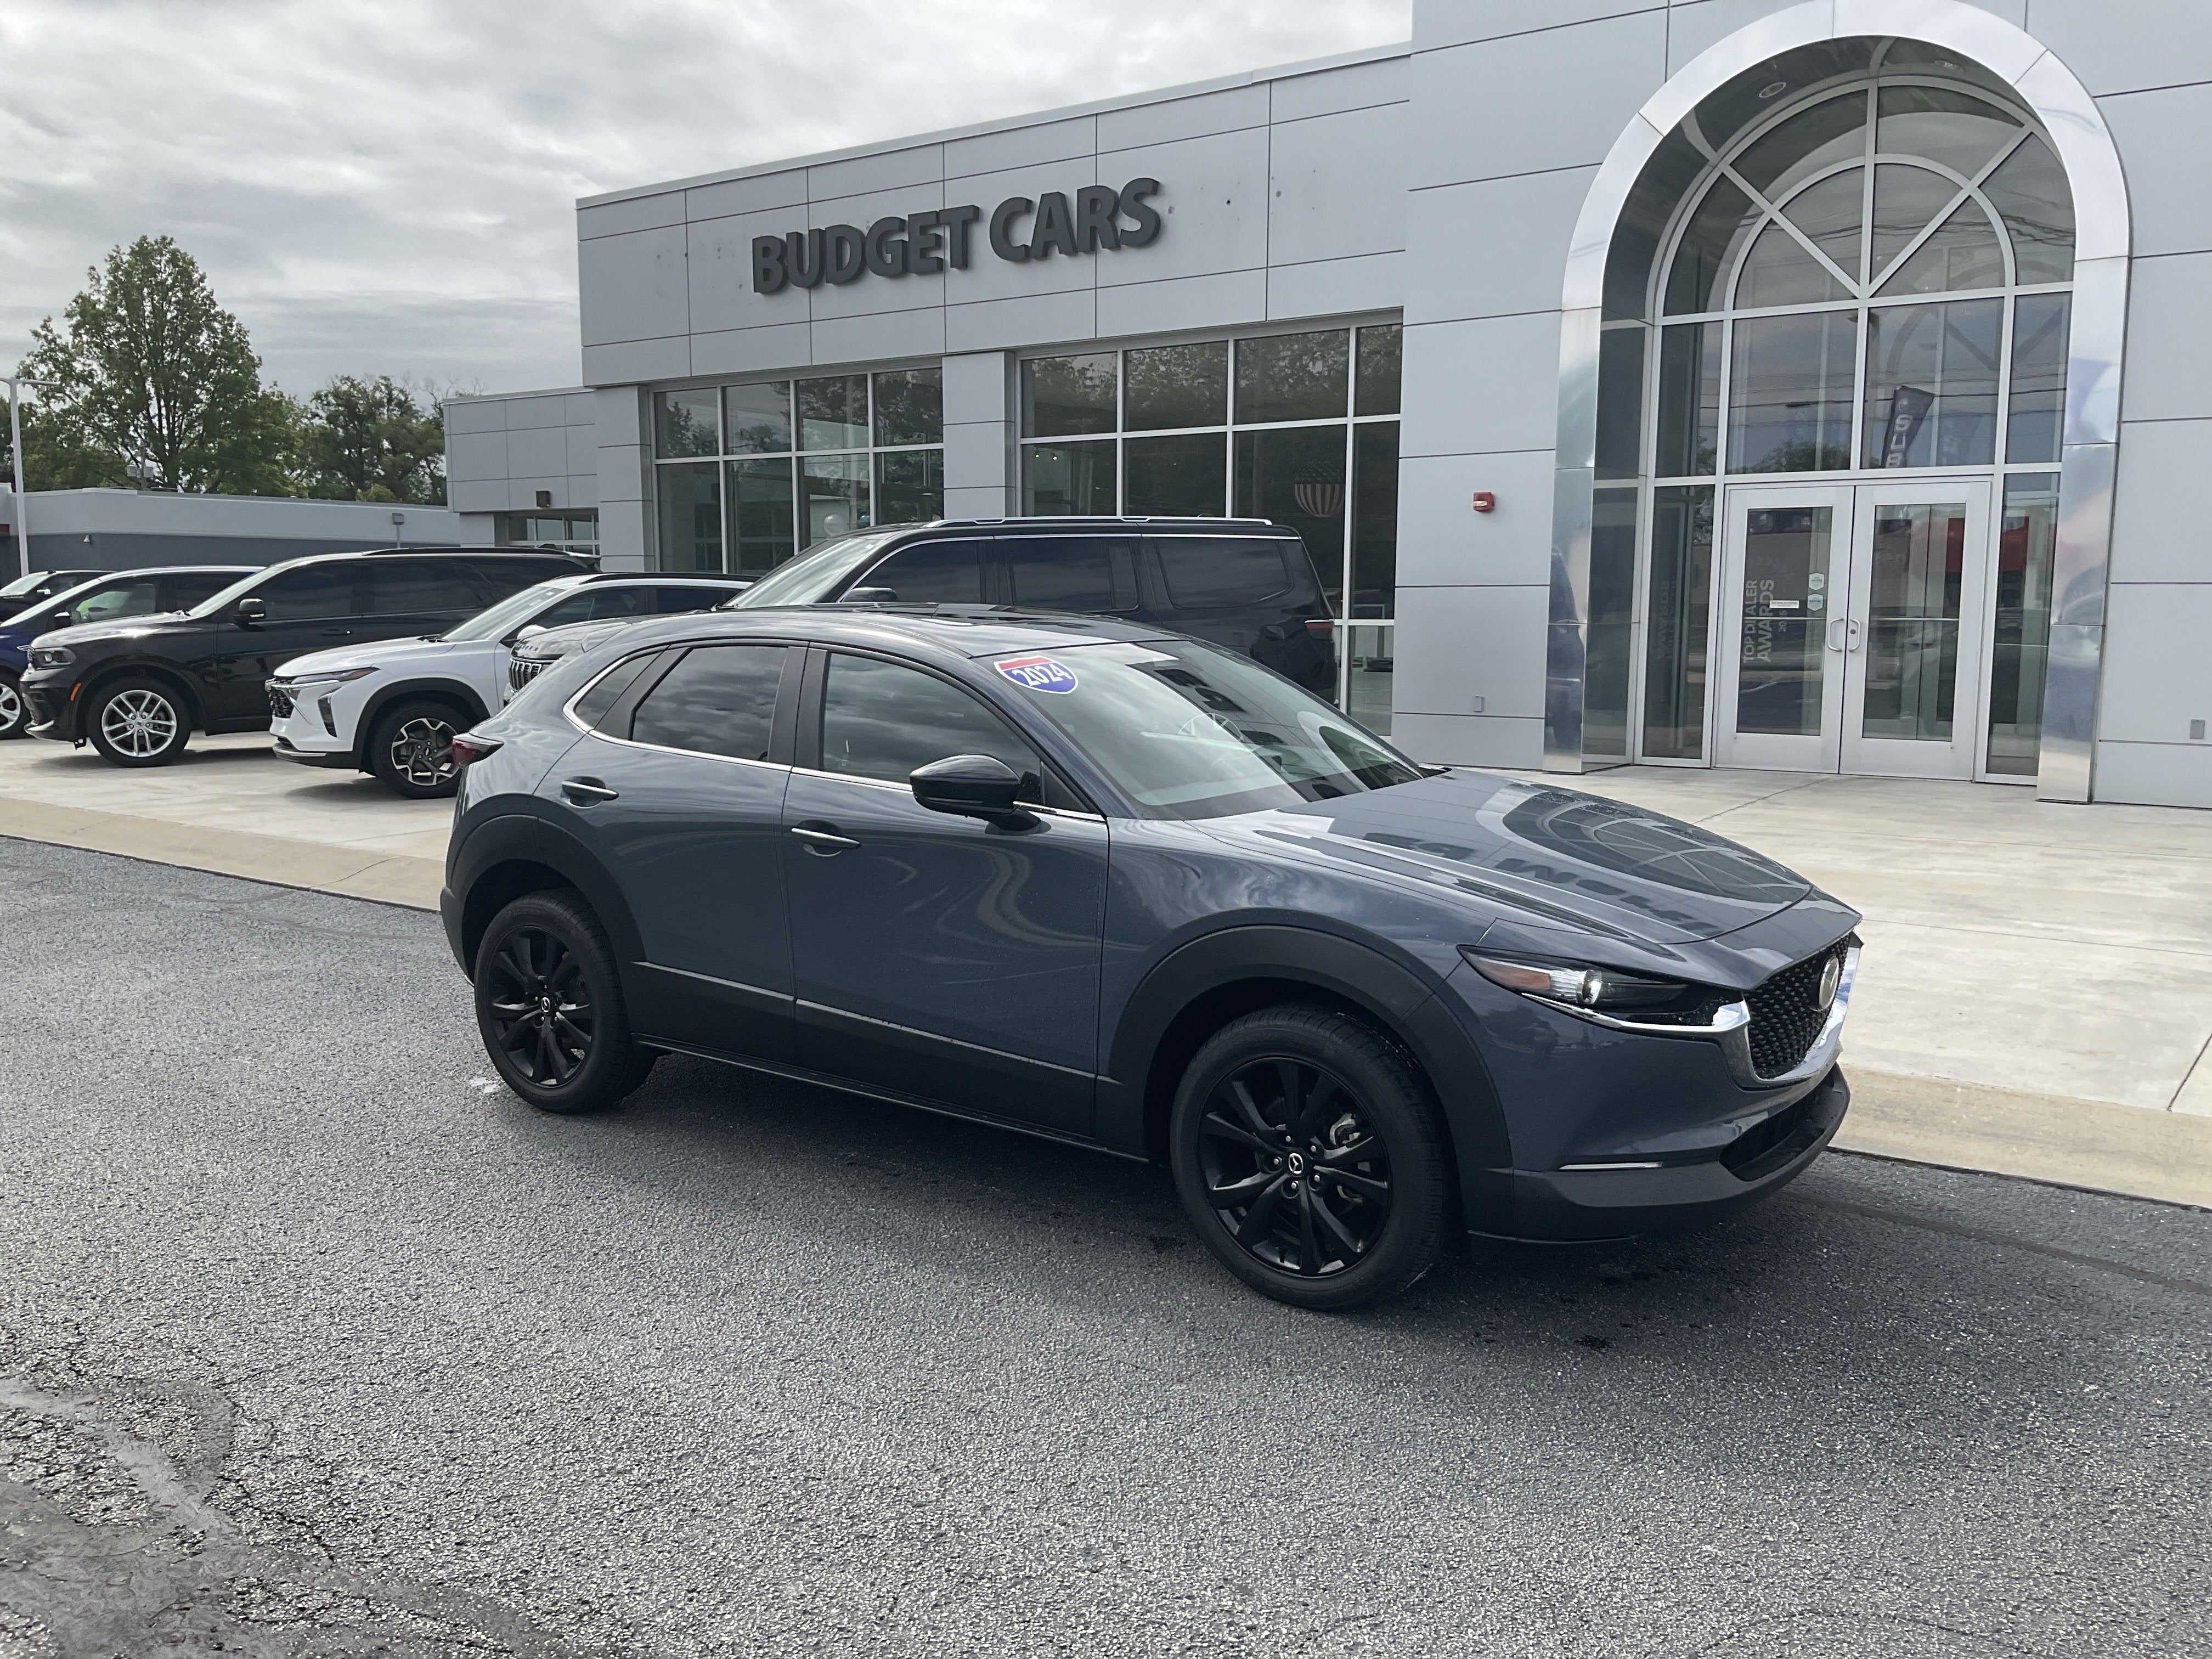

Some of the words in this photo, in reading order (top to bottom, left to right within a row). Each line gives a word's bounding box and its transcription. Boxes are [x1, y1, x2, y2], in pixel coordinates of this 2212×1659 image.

[752, 205, 979, 294] BUDGET
[989, 178, 1161, 262] CARS
[1745, 580, 1757, 634] DALER
[1757, 579, 1774, 663] AWARDS
[1012, 663, 1074, 686] 2024
[1743, 637, 1756, 663] TOP
